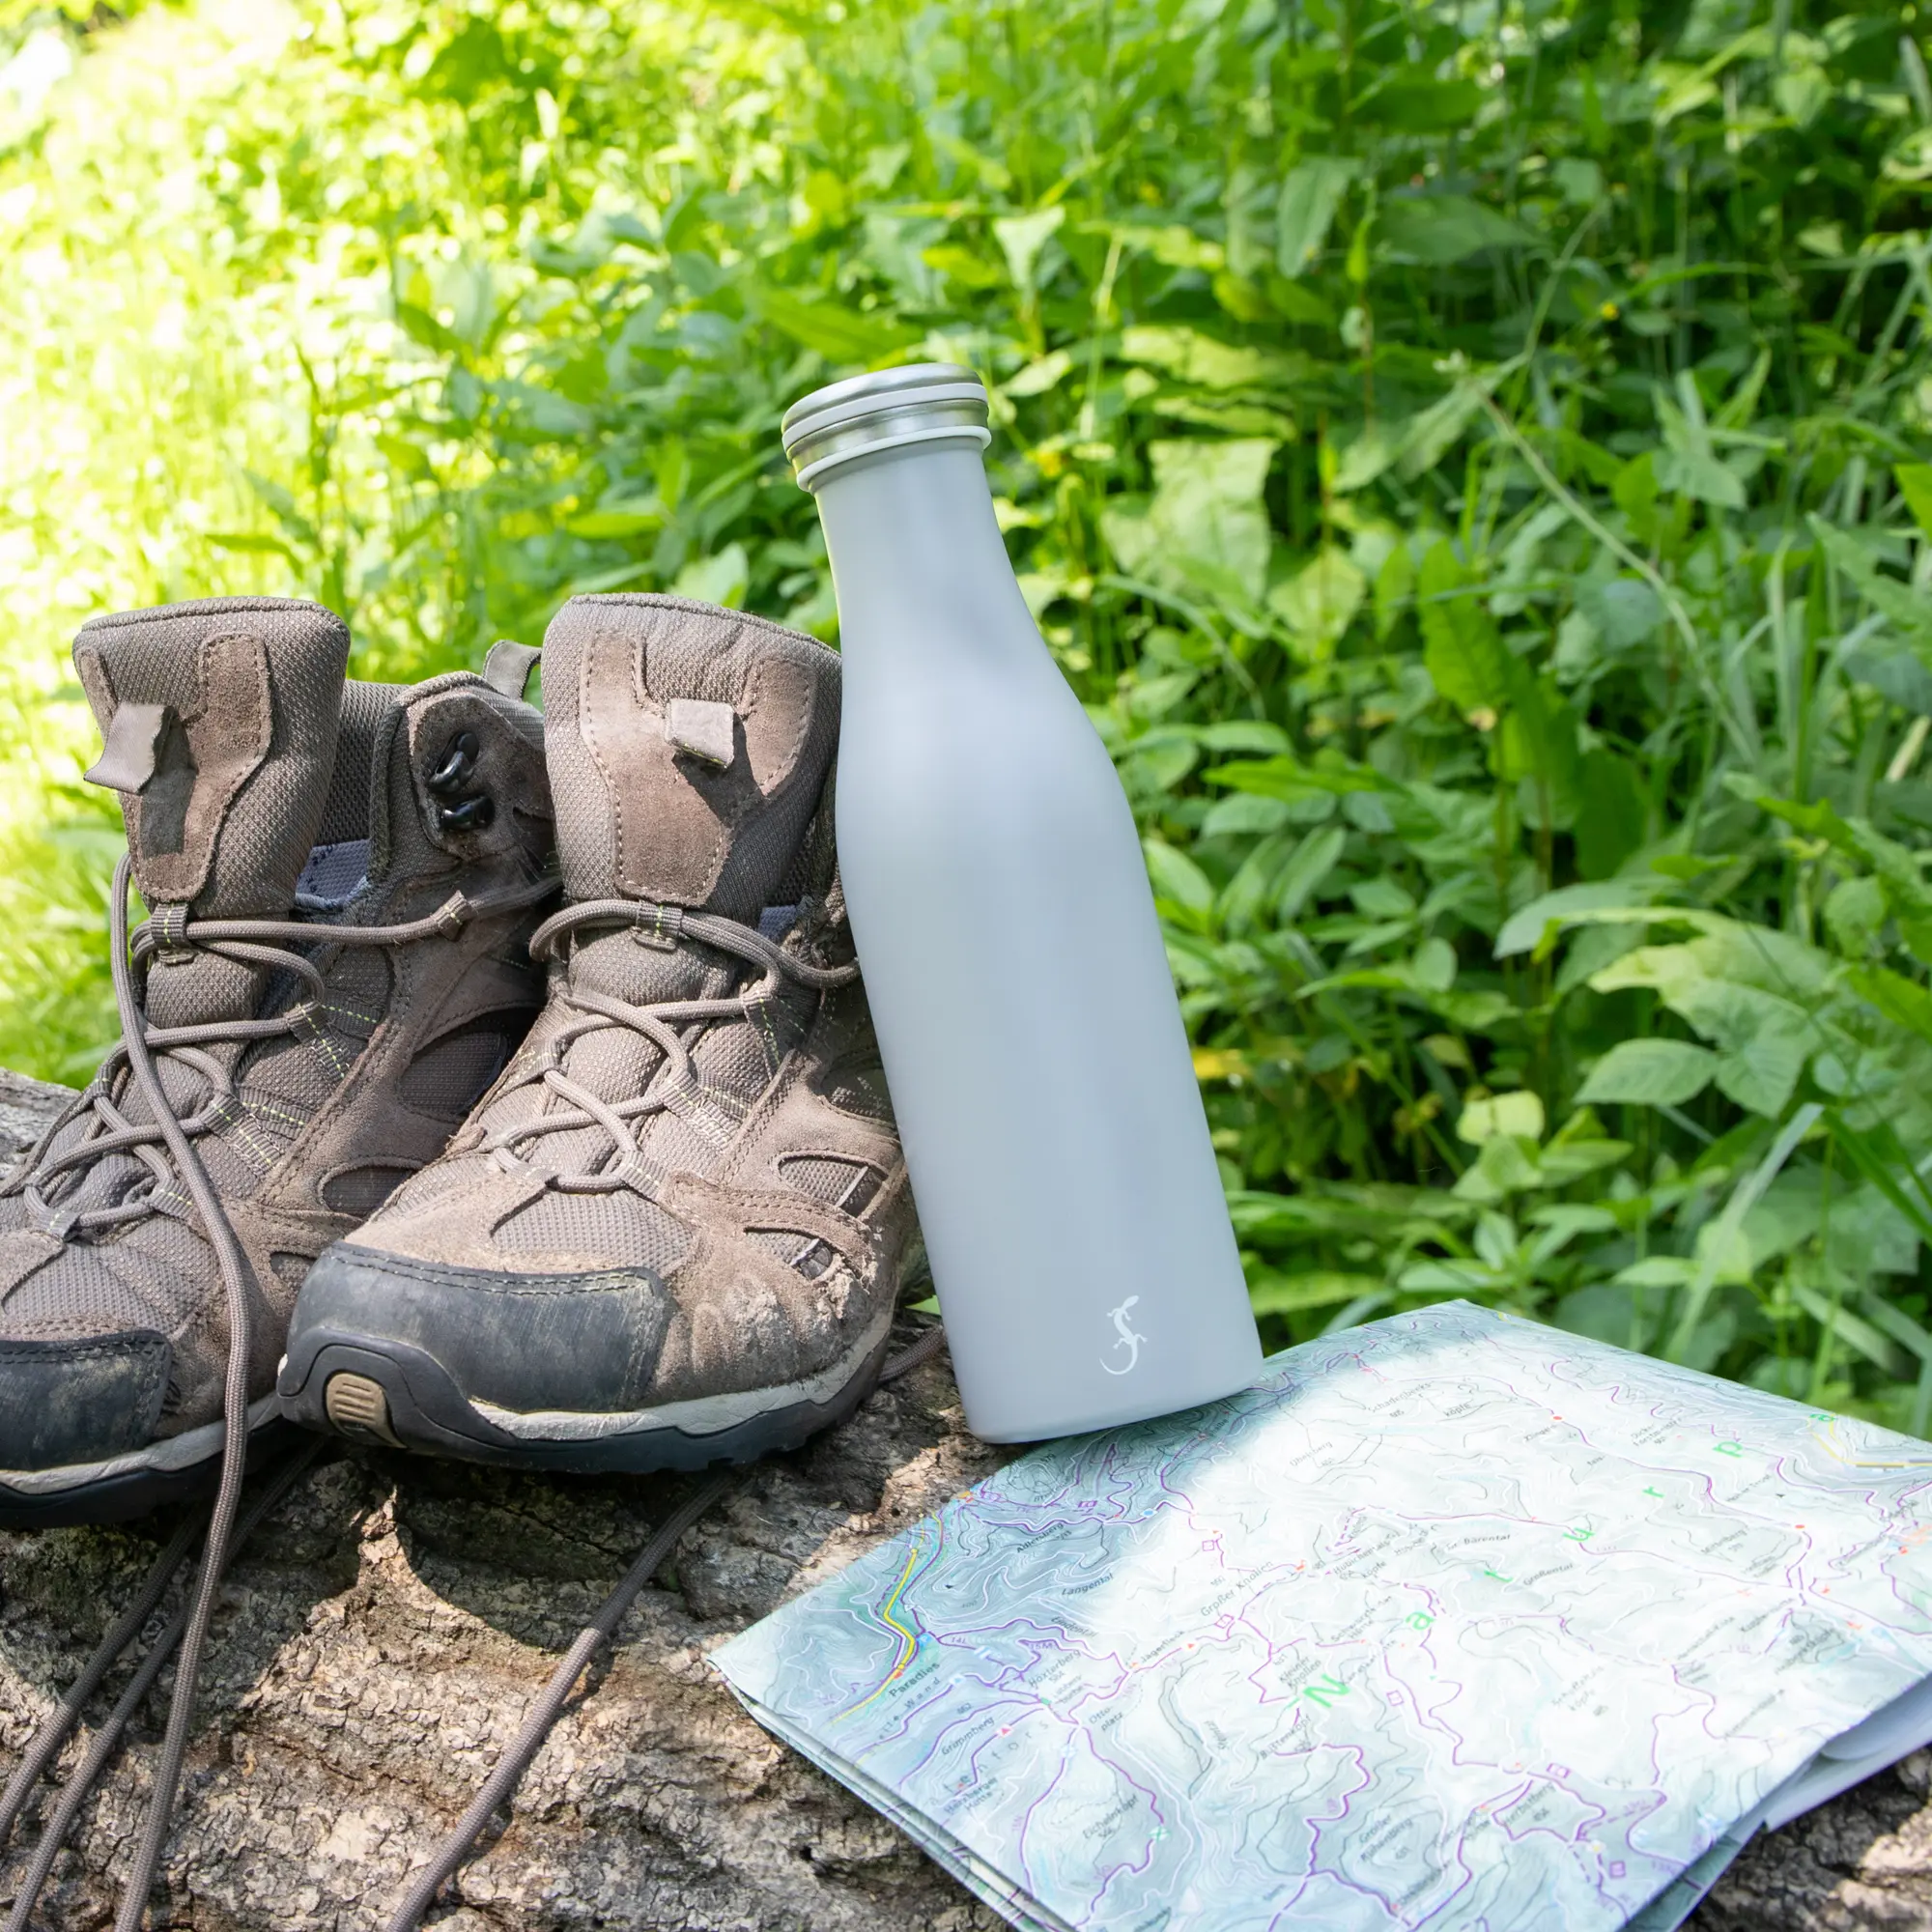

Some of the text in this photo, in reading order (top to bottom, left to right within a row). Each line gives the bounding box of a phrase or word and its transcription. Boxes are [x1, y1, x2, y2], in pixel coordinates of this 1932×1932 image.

[1061, 1573, 1114, 1596] Langental
[1236, 1561, 1273, 1590] Knollen
[889, 1662, 941, 1697] Paradies
[1101, 1712, 1124, 1731] platz
